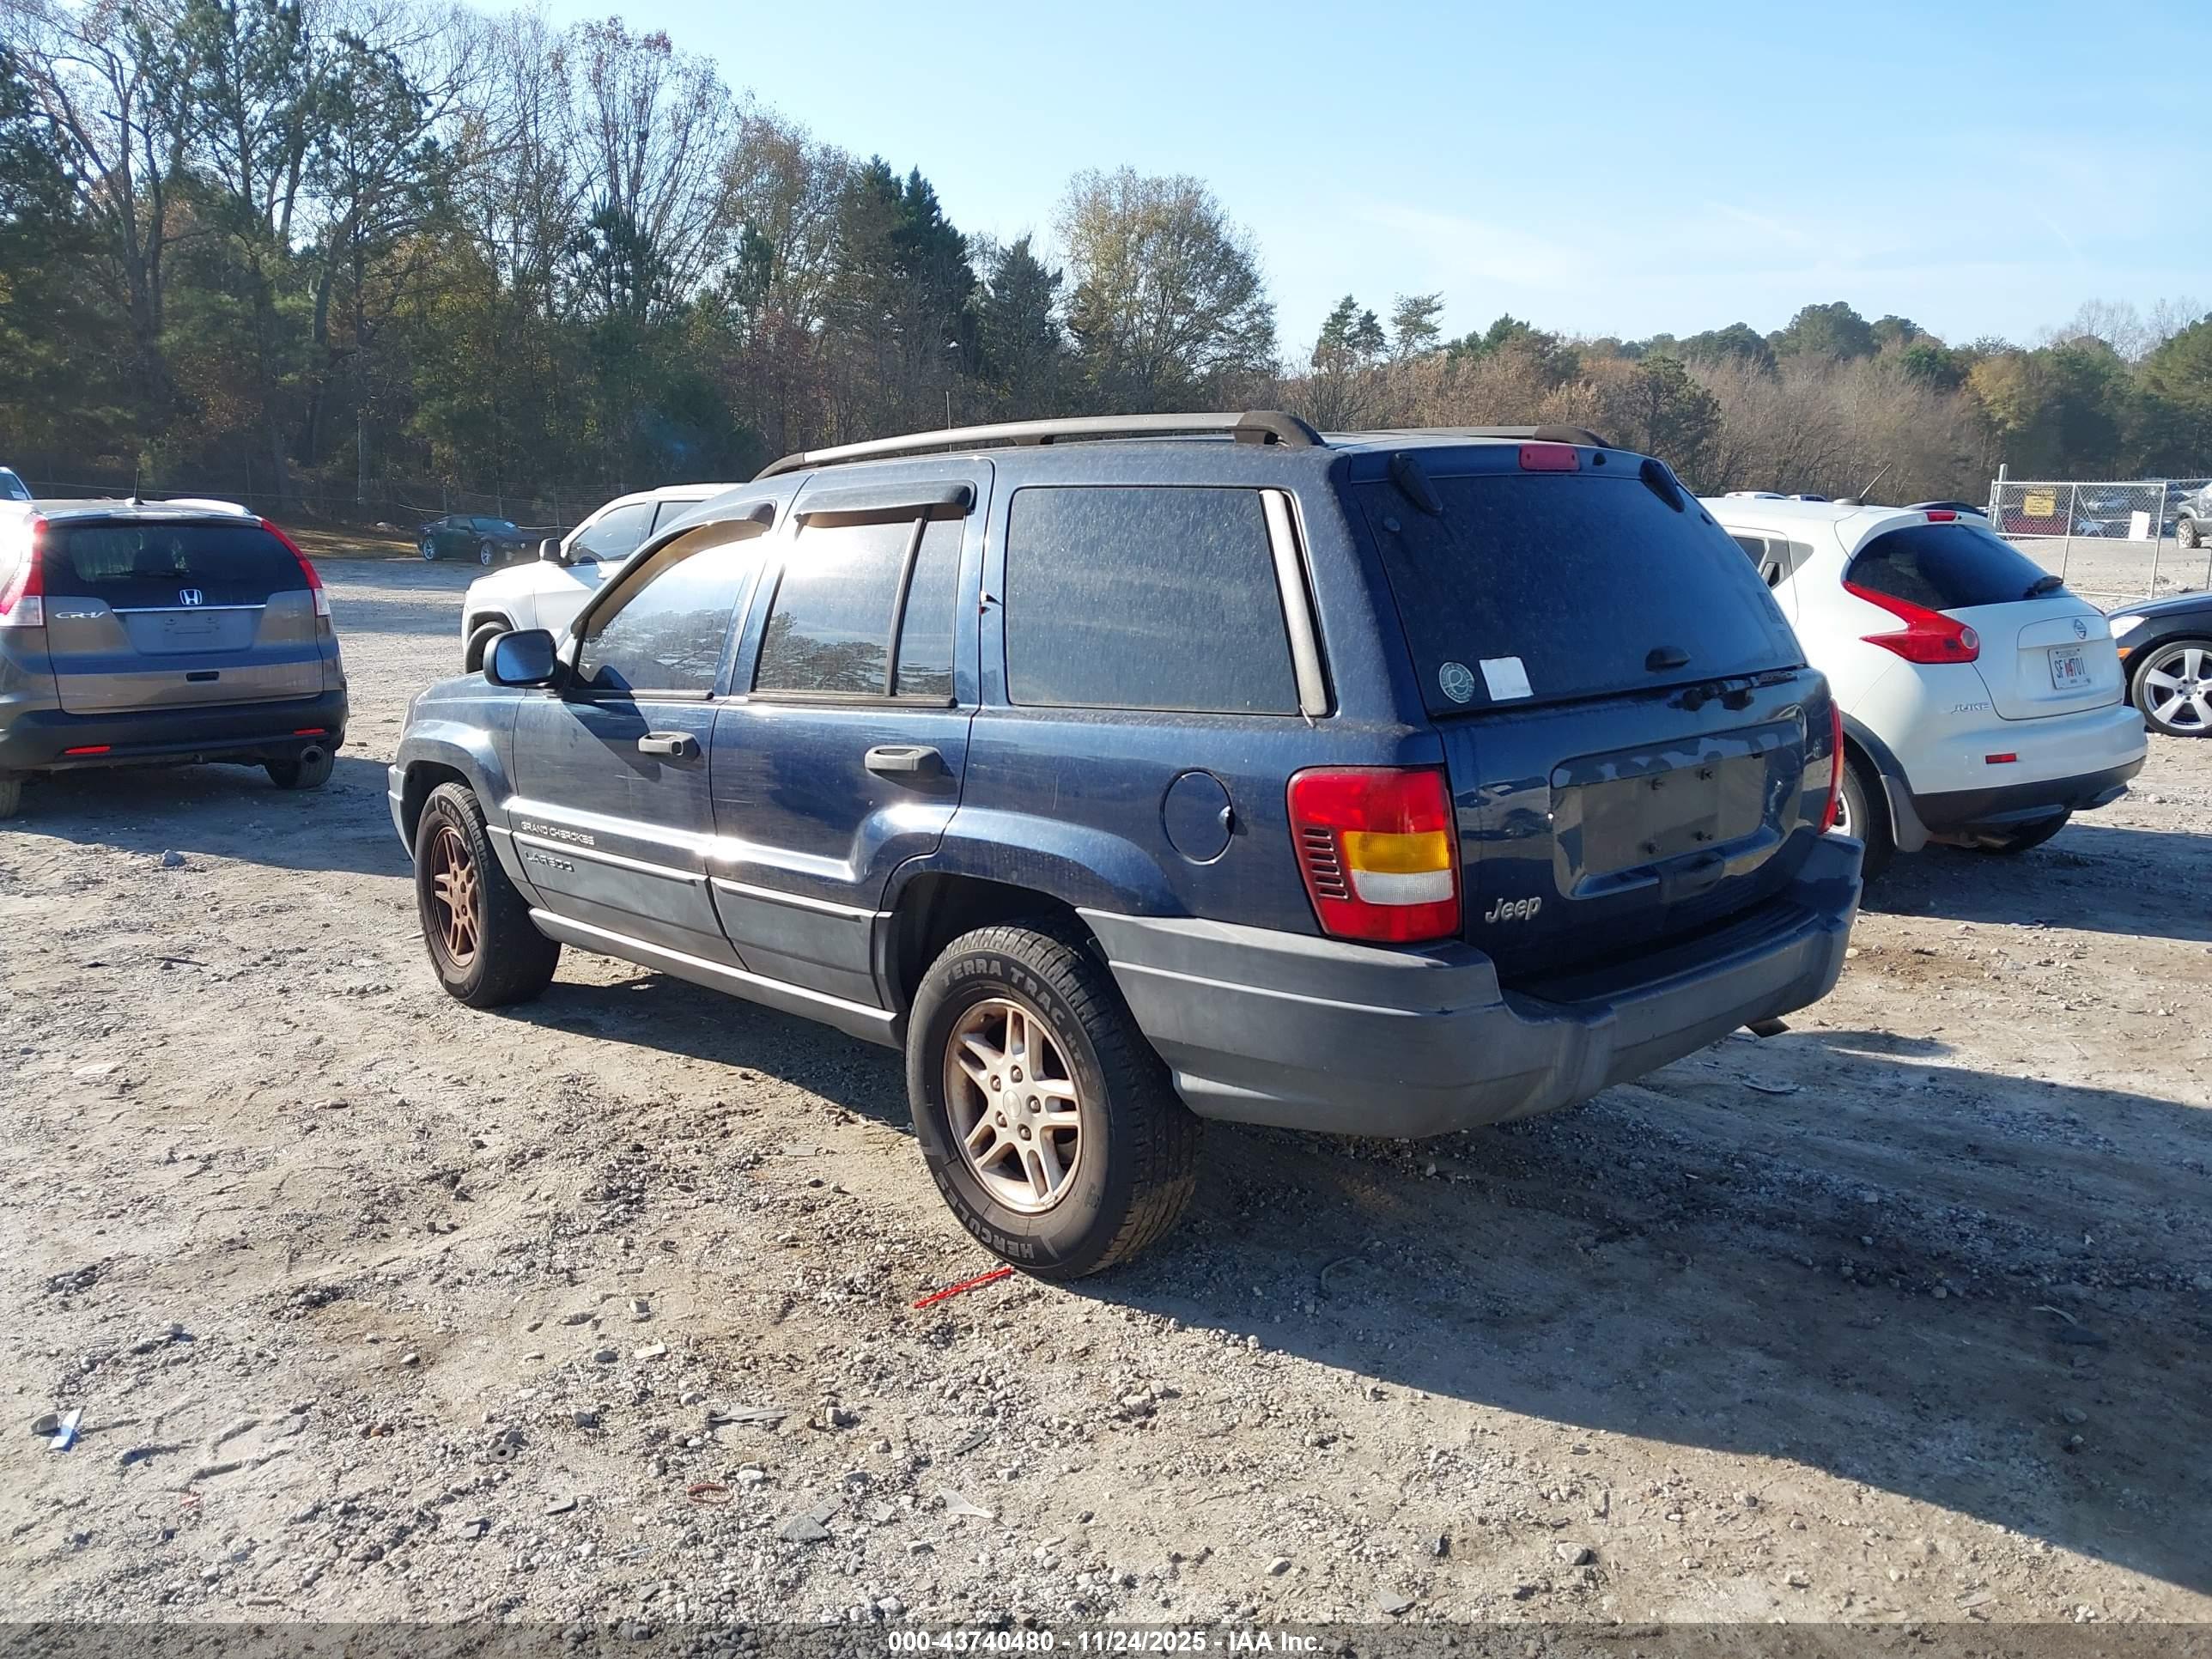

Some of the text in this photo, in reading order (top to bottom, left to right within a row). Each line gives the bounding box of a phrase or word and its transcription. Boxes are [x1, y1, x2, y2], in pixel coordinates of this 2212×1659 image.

[521, 821, 594, 845] GRAND CHEROKEE
[525, 851, 574, 872] LAREDO
[1486, 897, 1542, 922] Jeep
[942, 958, 1002, 986] TERRA
[1009, 967, 1065, 1025] TRAC
[935, 1172, 1035, 1259] HERCULES
